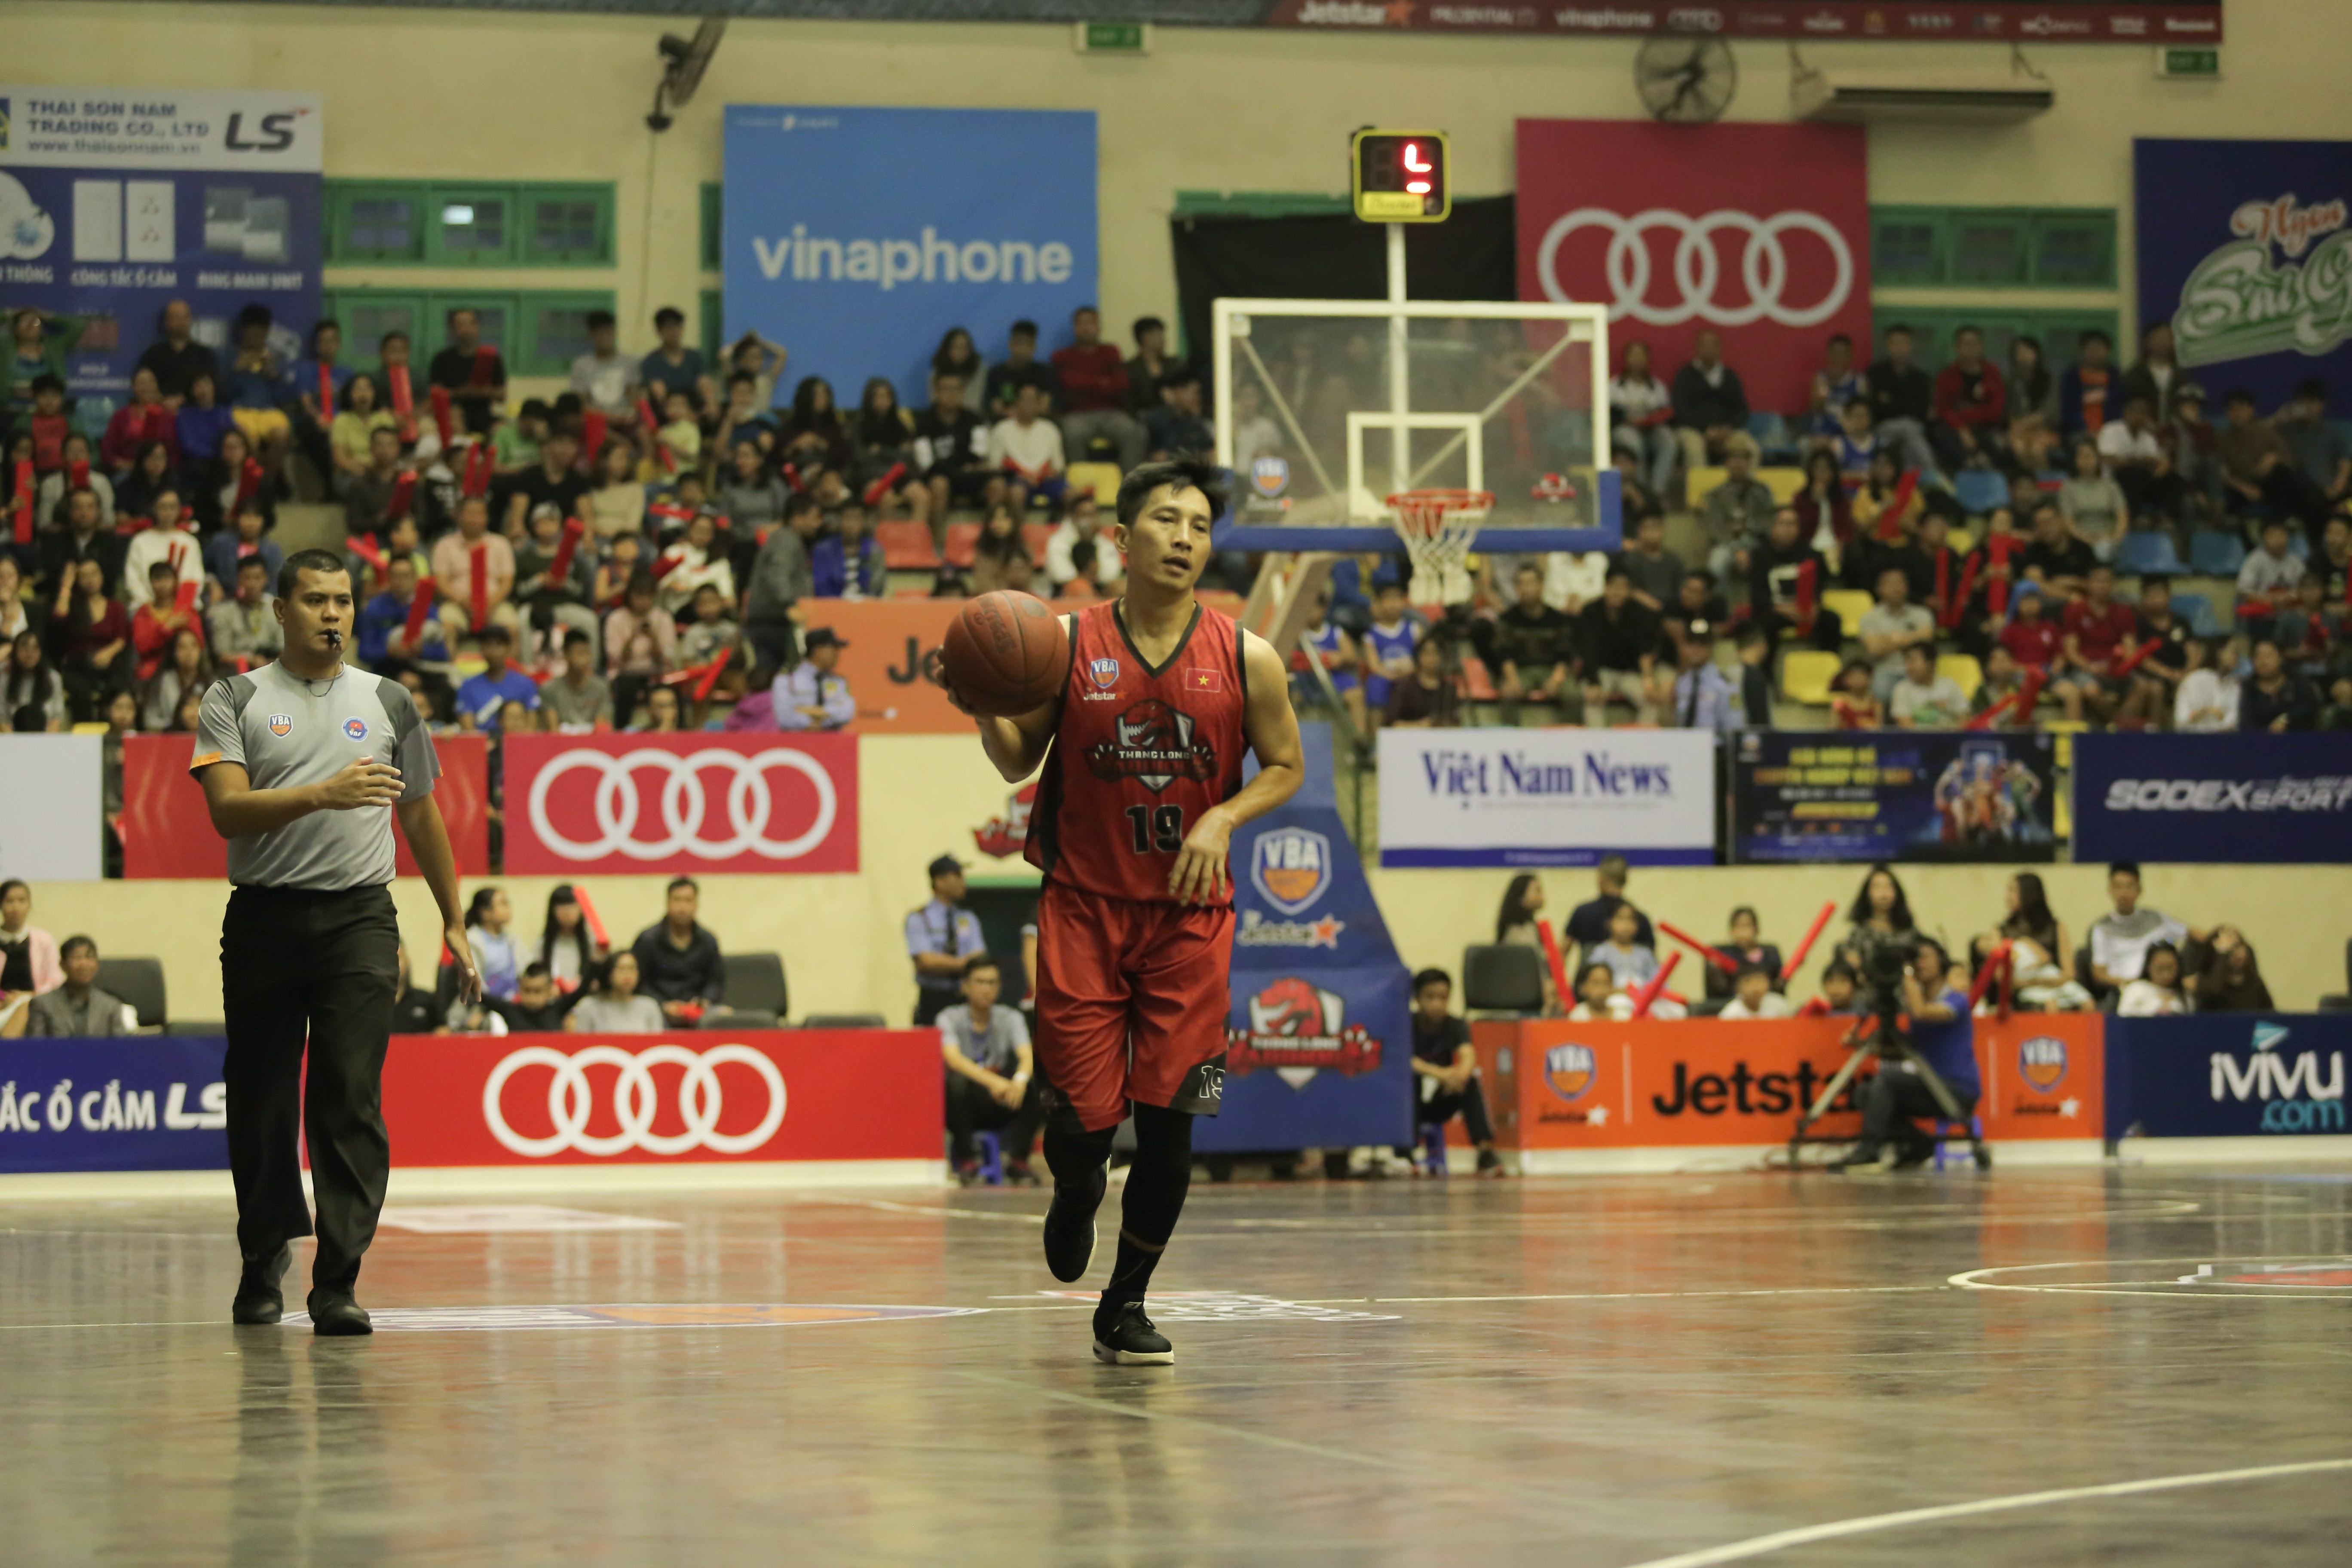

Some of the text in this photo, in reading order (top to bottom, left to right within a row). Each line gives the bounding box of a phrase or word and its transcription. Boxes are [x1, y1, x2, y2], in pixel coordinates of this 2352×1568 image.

[27, 101, 177, 116] THAI SON NAM
[27, 120, 120, 137] TRADING
[171, 122, 209, 137] LTD
[224, 111, 297, 152] LS
[753, 224, 1073, 291] vinaphone
[1094, 661, 1115, 672] VBA
[1083, 691, 1116, 701] Jetstar
[272, 716, 290, 725] VBA
[1161, 751, 1190, 760] LONG
[1421, 750, 1671, 809] Việt Nam News
[2106, 779, 2251, 812] SODEX
[1126, 804, 1183, 854] 19
[1264, 836, 1320, 870] VBA
[1548, 1045, 1593, 1072] VBA
[2024, 1039, 2063, 1065] VBA
[1199, 1065, 1225, 1099] 19
[1652, 1061, 1873, 1116] Jetsta
[164, 1082, 227, 1130] LS
